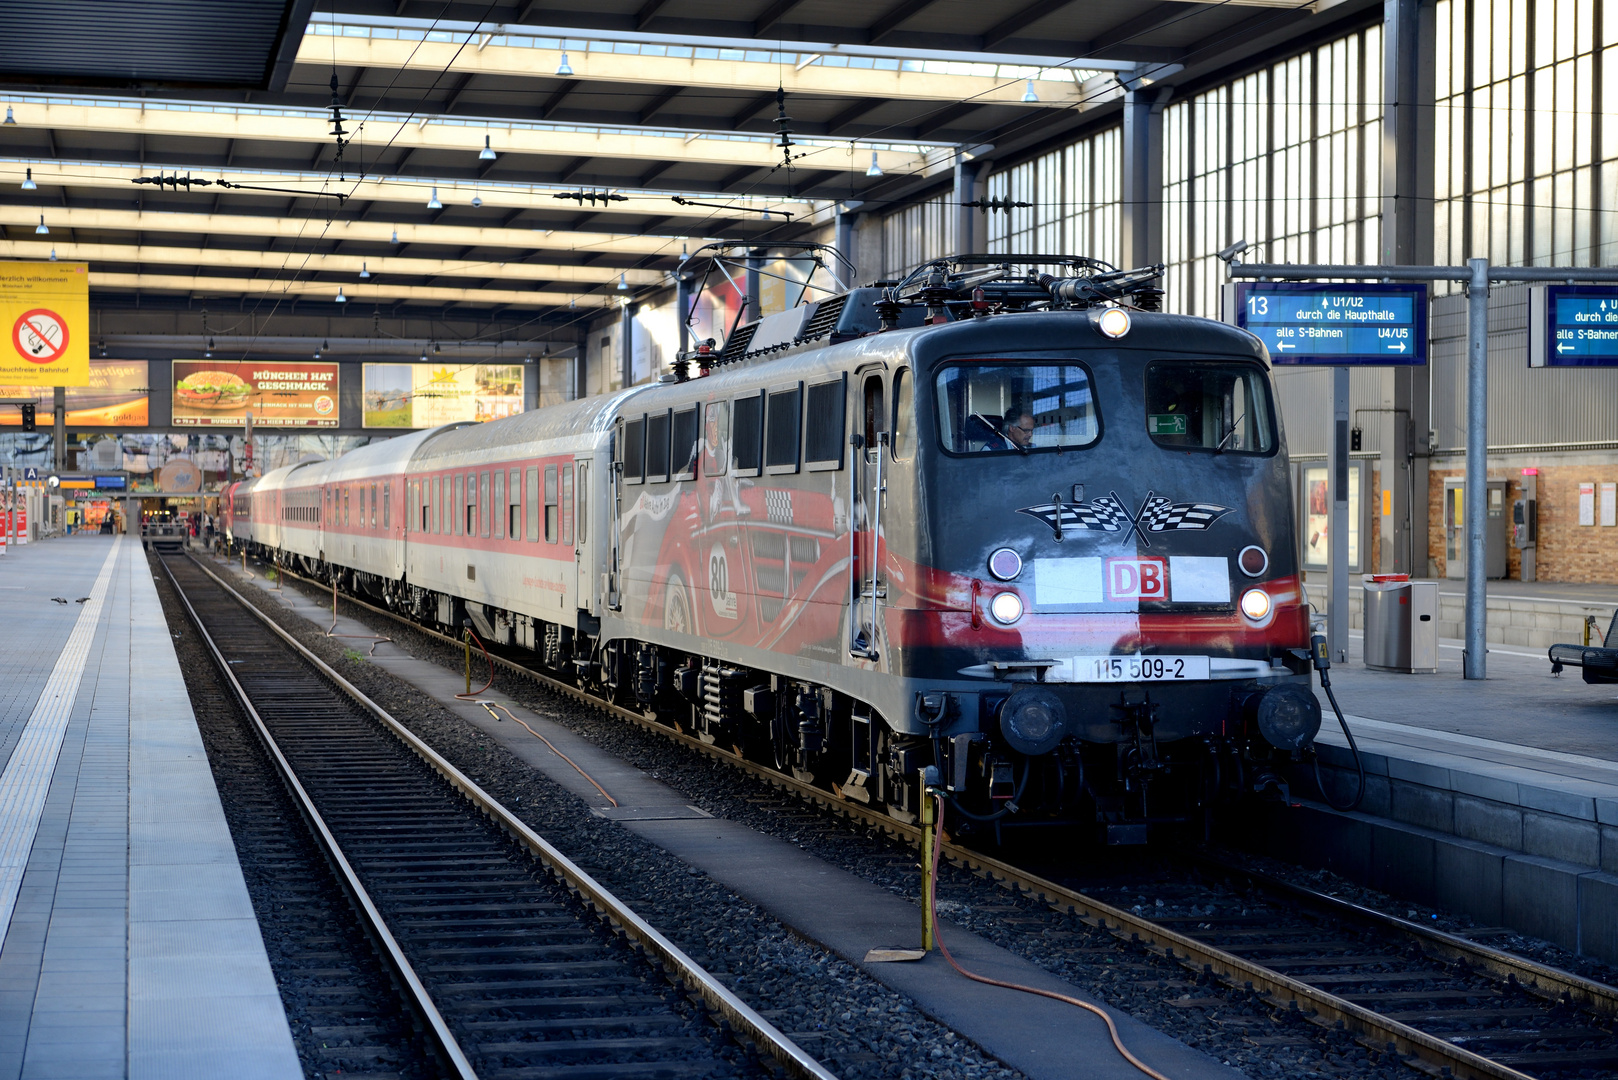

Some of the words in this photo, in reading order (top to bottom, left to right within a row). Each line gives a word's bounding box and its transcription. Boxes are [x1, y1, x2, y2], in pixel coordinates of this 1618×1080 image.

[1248, 296, 1268, 315] 13
[1333, 297, 1364, 307] U1/U2
[1610, 299, 1618, 309] U
[1296, 309, 1323, 320] durch
[1327, 309, 1341, 320] die
[1345, 309, 1395, 323] Haupthalle
[1575, 311, 1601, 322] durch
[1605, 311, 1618, 322] die
[1276, 327, 1295, 338] alle
[1299, 327, 1343, 338] S-Bahnen
[1378, 328, 1409, 339] U4/U5
[1556, 329, 1574, 339] alle
[253, 369, 308, 381] MÜNCHEN
[310, 371, 334, 382] HAT
[257, 381, 330, 391] GESCHMACK.
[113, 413, 146, 423] goldgas
[27, 468, 36, 479] A
[711, 555, 727, 601] 80
[1114, 563, 1161, 595] DB
[1094, 659, 1123, 679] 115
[1129, 658, 1185, 679] 509-2
